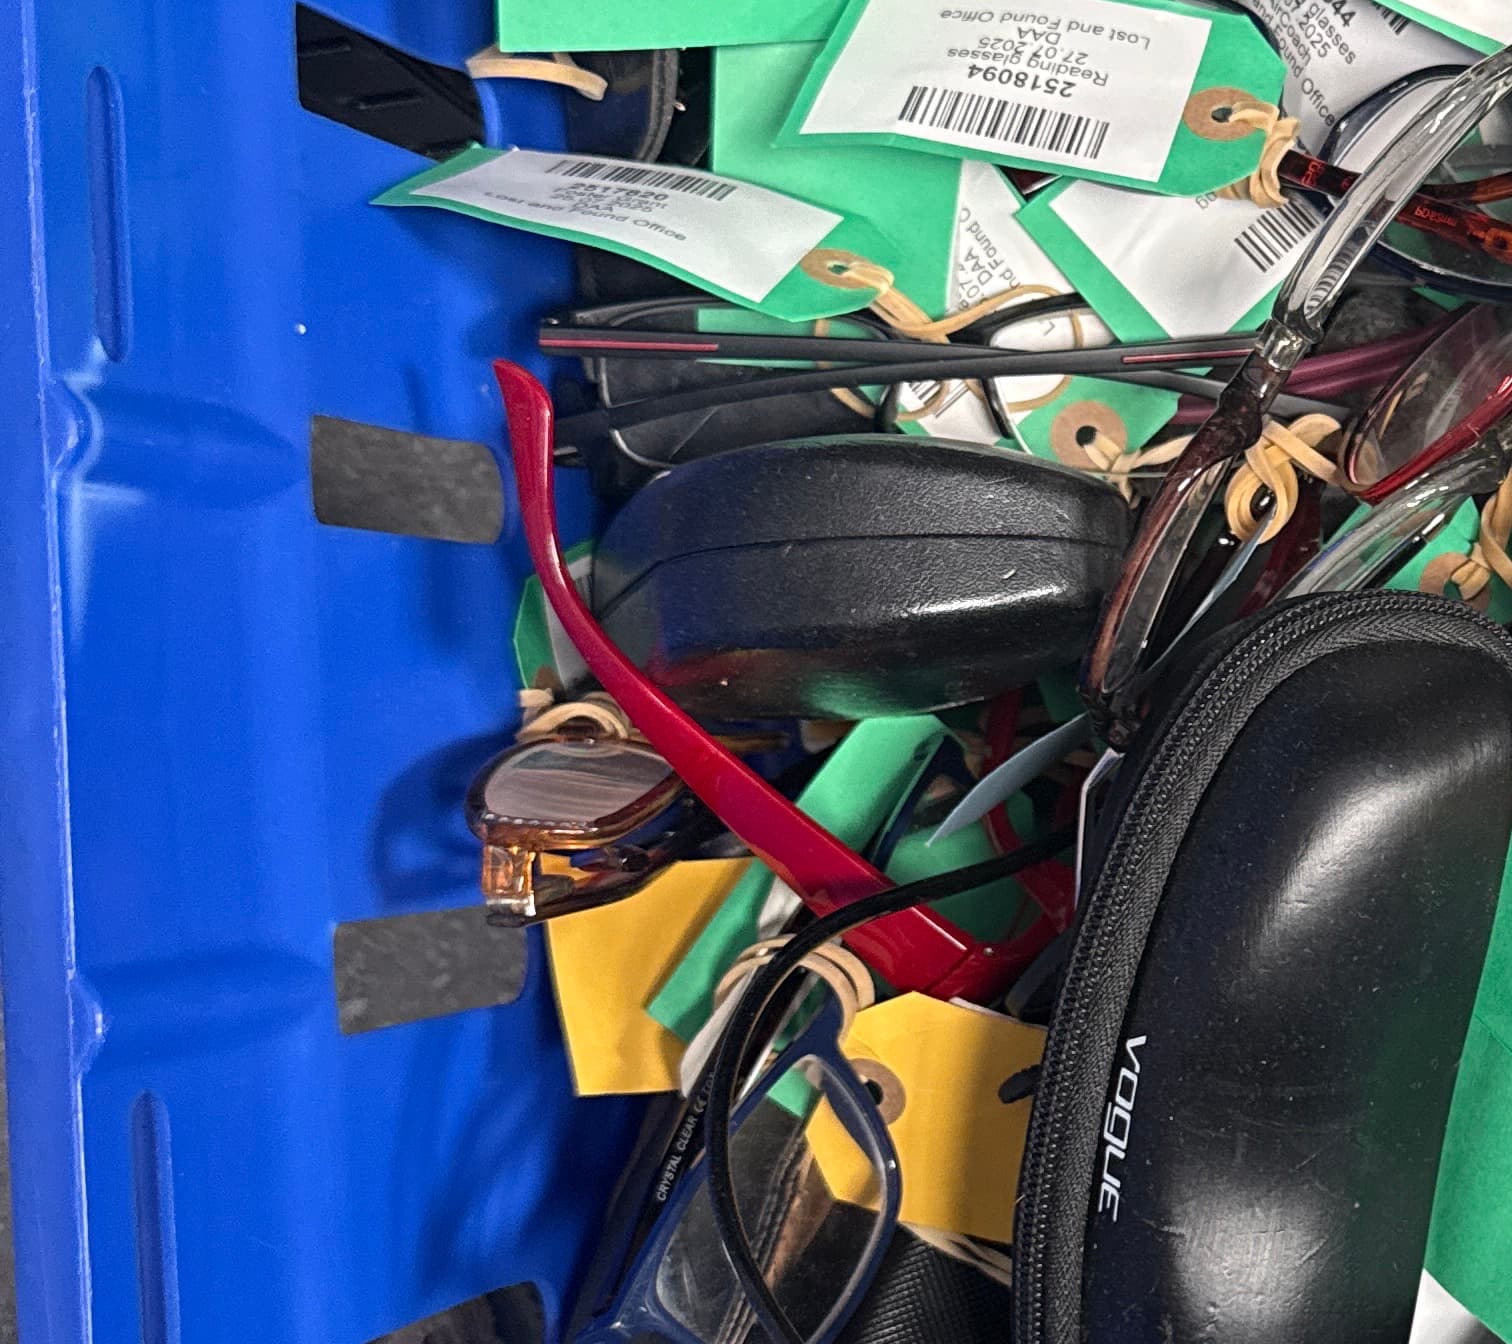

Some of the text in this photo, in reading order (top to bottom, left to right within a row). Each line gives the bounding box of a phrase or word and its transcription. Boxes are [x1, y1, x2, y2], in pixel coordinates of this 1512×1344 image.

[939, 9, 1150, 50] Lost and Found Office
[1017, 26, 1060, 45] DAA
[1304, 1, 1356, 64] glasses
[946, 48, 1108, 86] Reading glasses
[977, 36, 1088, 65] 27.07.2025
[967, 63, 1075, 97] 2518094
[1270, 23, 1304, 78] Found
[1299, 77, 1339, 127] Office
[965, 220, 1004, 270] Found
[963, 247, 993, 285] DAA
[1096, 1035, 1147, 1221] VOGUE
[655, 1154, 681, 1201] CRYSTAL
[675, 1115, 698, 1152] CLEAR
